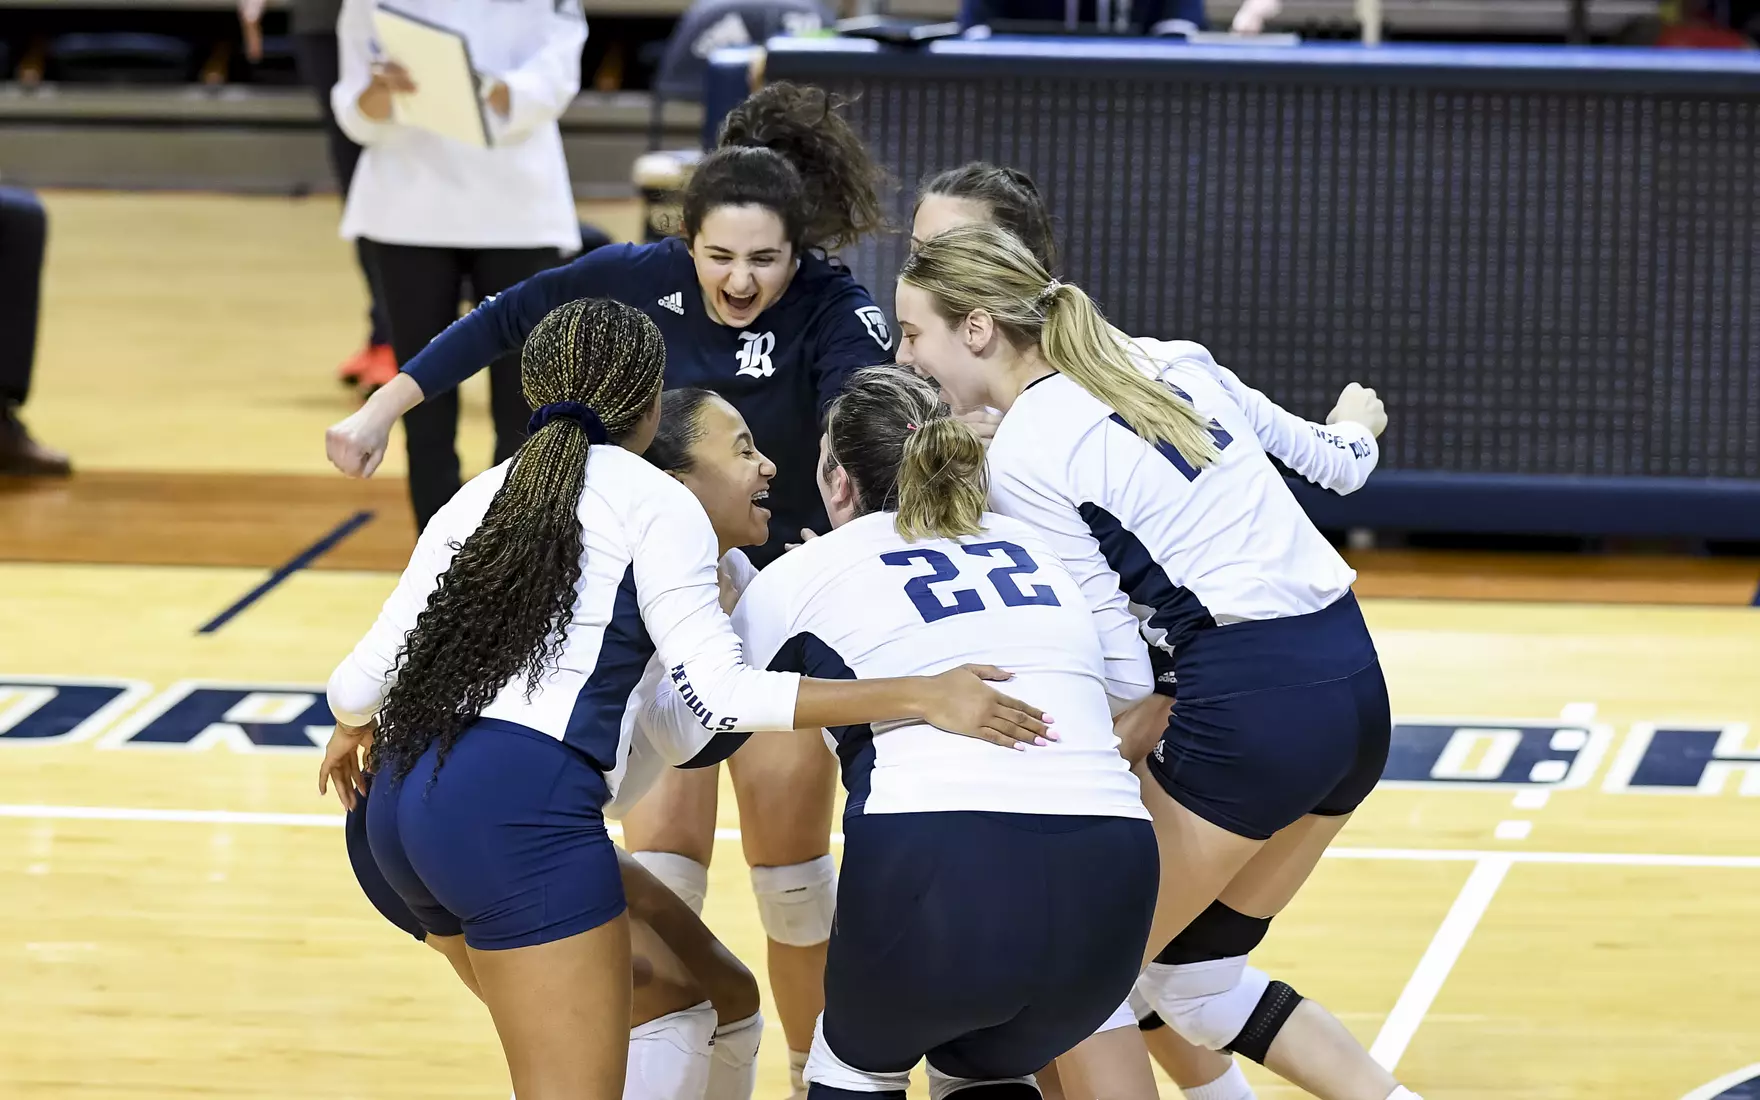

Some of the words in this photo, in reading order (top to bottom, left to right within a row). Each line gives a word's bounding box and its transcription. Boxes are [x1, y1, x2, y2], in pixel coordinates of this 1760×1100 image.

[735, 330, 776, 379] R
[879, 540, 1062, 623] 22
[679, 681, 738, 731] OWLS
